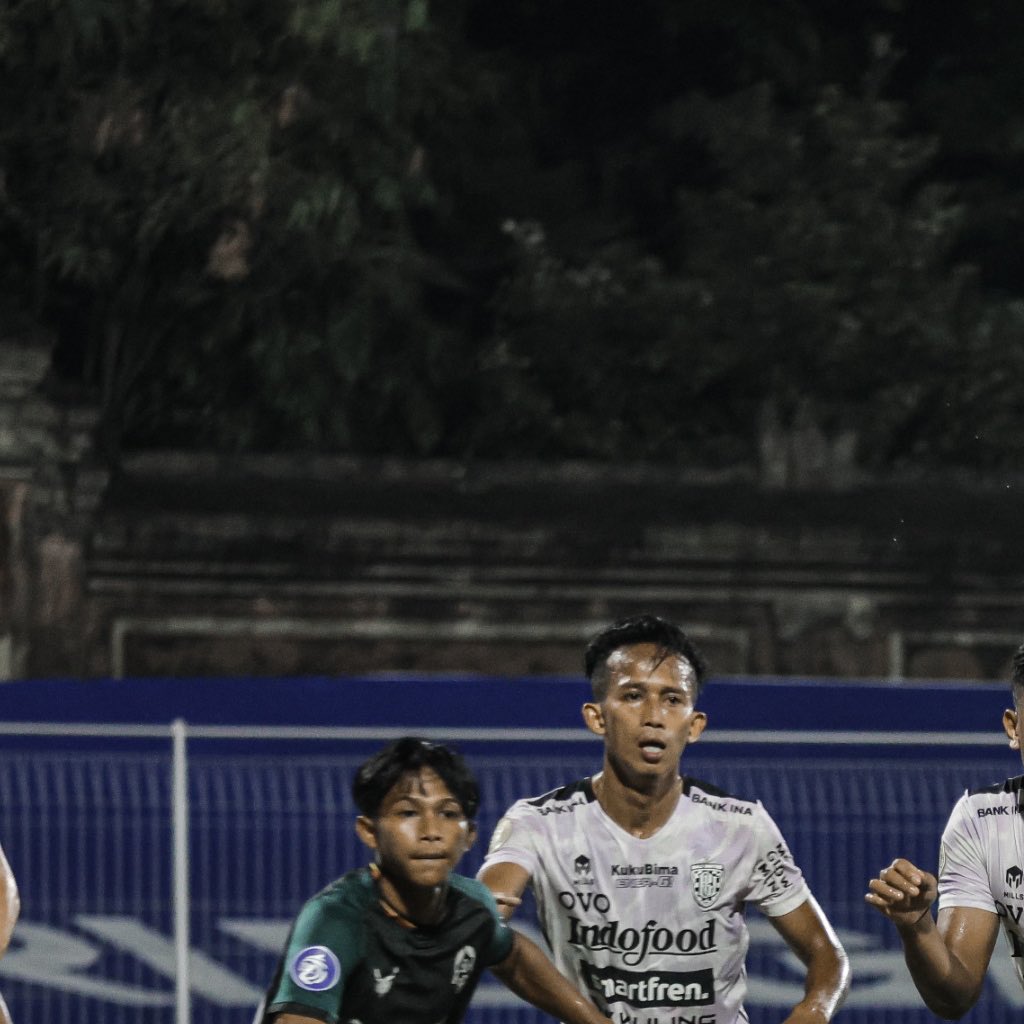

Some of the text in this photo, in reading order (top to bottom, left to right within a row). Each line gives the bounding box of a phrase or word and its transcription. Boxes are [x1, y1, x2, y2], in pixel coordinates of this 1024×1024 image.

[730, 801, 753, 816] INA
[977, 805, 1009, 818] BANK
[611, 863, 678, 876] KukuBima
[558, 891, 611, 914] OVO
[1003, 891, 1024, 901] MILLS
[569, 918, 717, 966] Indofood
